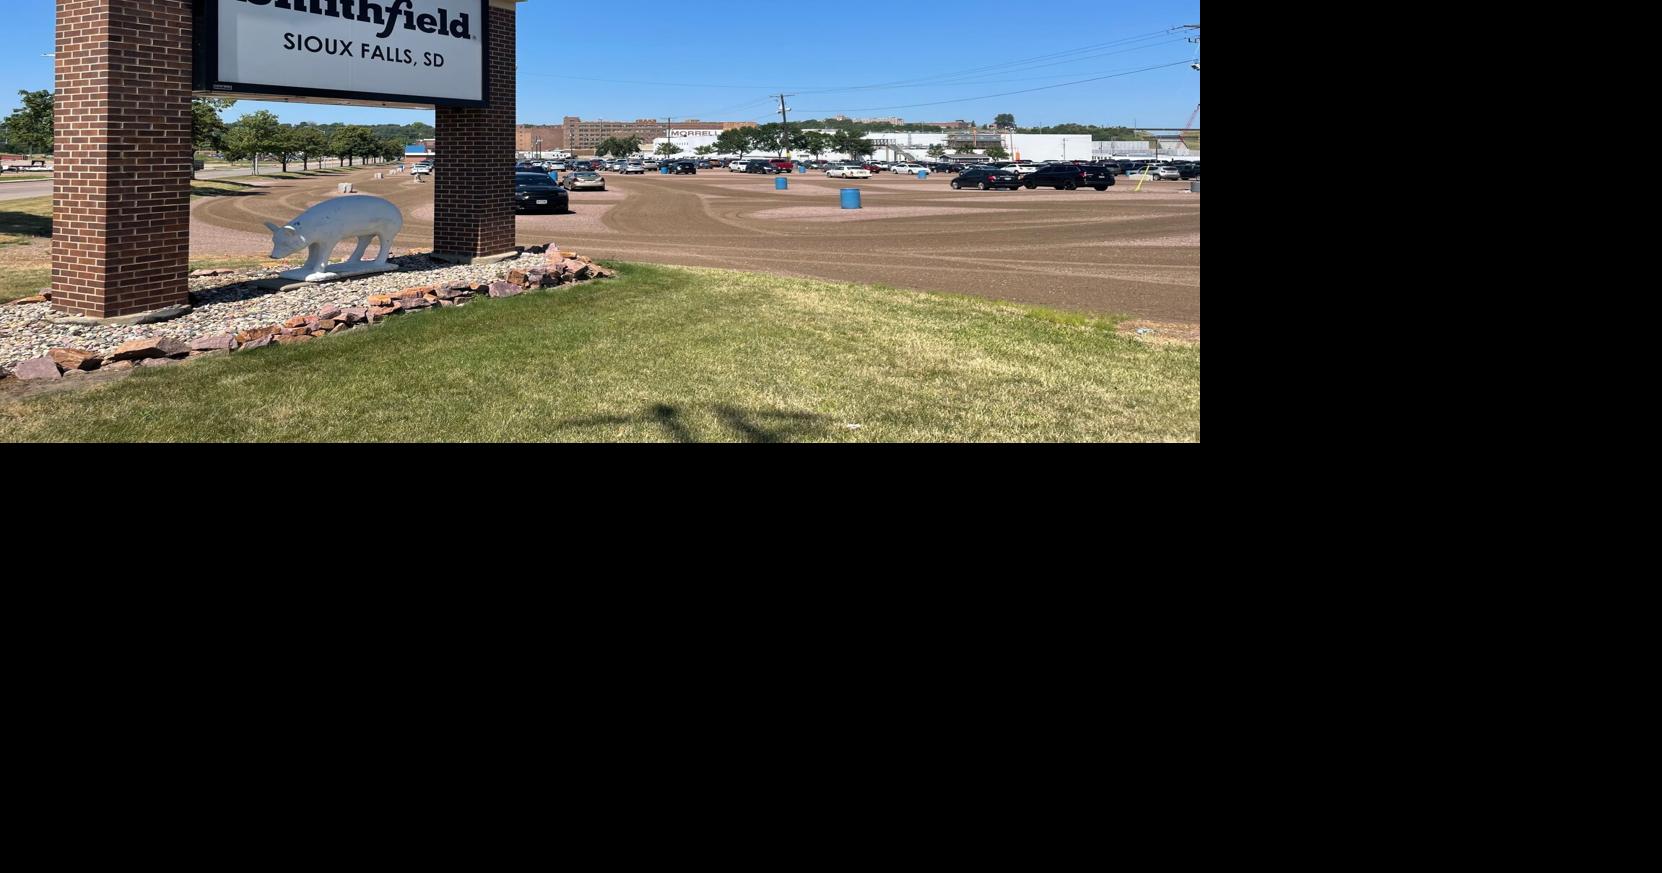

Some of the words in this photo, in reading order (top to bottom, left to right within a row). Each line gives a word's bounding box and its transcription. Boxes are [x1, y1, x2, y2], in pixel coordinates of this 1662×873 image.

[237, 0, 471, 39] mithfield
[283, 32, 353, 58] SIOUX
[361, 43, 418, 67] FALLS,
[423, 51, 445, 68] SD
